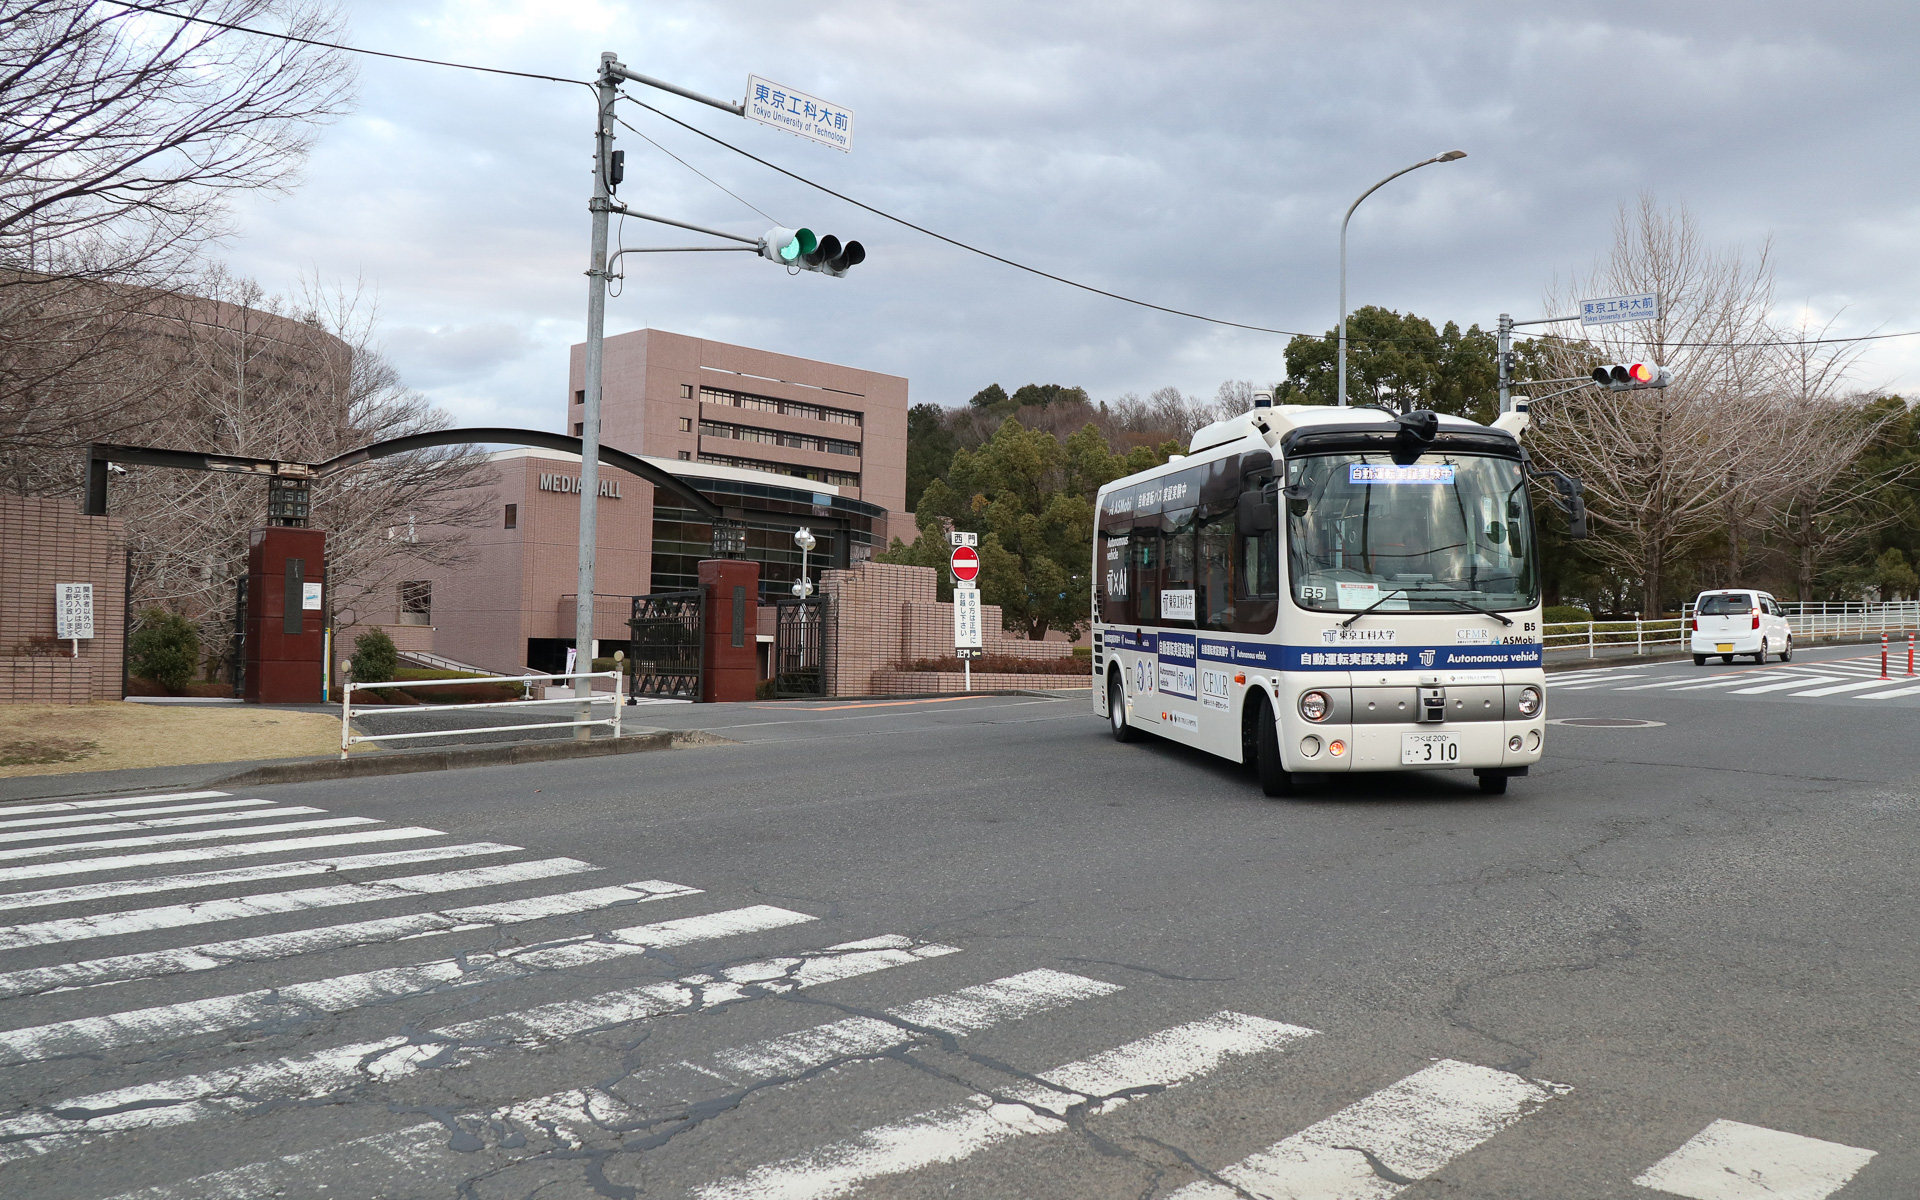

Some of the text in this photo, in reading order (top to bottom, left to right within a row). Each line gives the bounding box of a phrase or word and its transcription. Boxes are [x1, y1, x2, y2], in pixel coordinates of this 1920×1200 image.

[754, 83, 848, 131] 東京工科大前
[753, 103, 847, 145] Tokyo University of Technology
[1584, 297, 1653, 314] 東京工科大前
[1598, 313, 1620, 321] University
[540, 472, 623, 498] MEDIA ALL
[954, 533, 976, 545] 西門
[1169, 594, 1193, 609] 東京工科大学
[1303, 588, 1324, 599] B5
[65, 586, 73, 636] お断り致します
[74, 586, 82, 636] 立ち入りは固く
[83, 586, 91, 630] 関係者以外の
[968, 592, 977, 644] 車の方は正門に
[1340, 630, 1395, 640] 東京工科大学
[1524, 623, 1536, 631] B5
[1502, 636, 1536, 645] ASMobi
[1300, 652, 1409, 666] 自動運転実証実験中
[1446, 651, 1539, 663] Autonomous vehicle
[1203, 671, 1229, 696] CFMR
